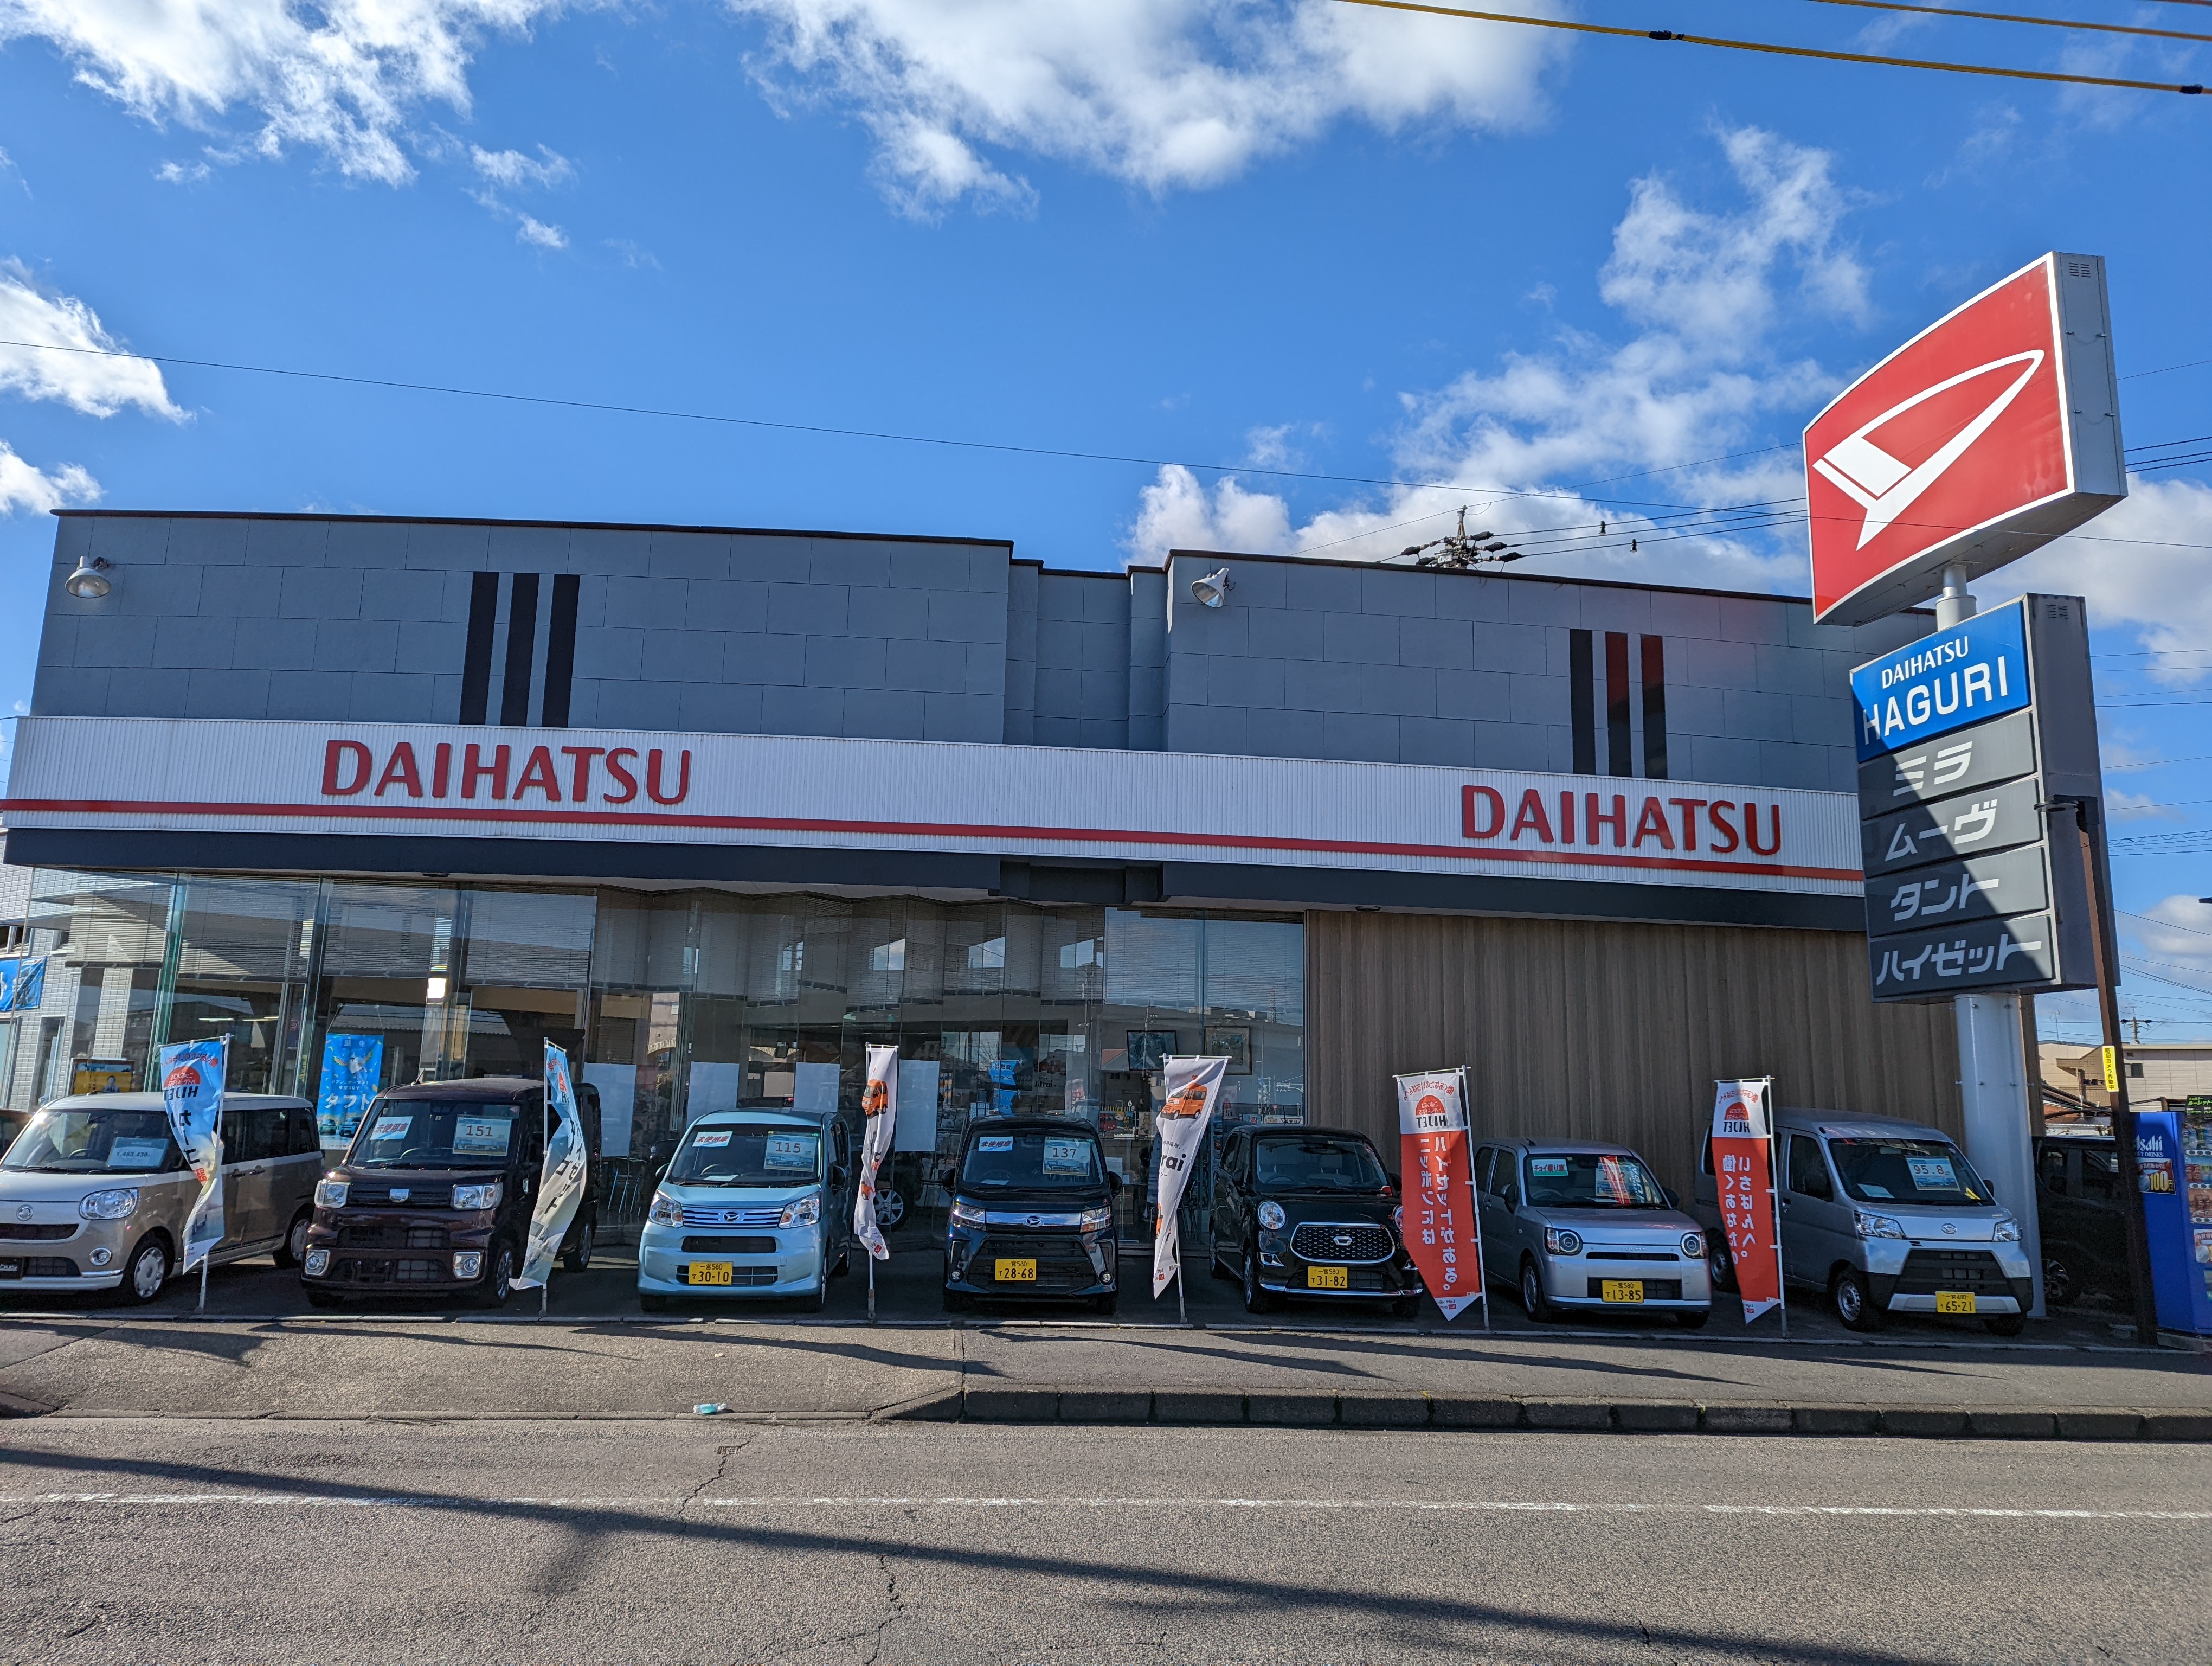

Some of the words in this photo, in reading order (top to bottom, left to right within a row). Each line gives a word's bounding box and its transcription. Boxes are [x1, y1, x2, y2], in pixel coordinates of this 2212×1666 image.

[1881, 636, 1969, 689] DAIHATSU
[1862, 656, 2009, 745] HAGURI
[321, 740, 691, 805] DAIHATSU
[1893, 741, 1973, 796] ミラ
[1462, 785, 1781, 855] DAIHATSU
[1885, 799, 1998, 862] ムーヴ
[1891, 873, 1999, 921] タント
[1876, 934, 2042, 985] ハイゼット
[2105, 1048, 2114, 1090] 防犯カメラ作動中
[325, 1093, 370, 1110] タフト
[374, 1123, 409, 1133] 未使用車
[466, 1125, 493, 1137] 151
[775, 1142, 801, 1154] 115
[2134, 1135, 2163, 1151] Asahi
[1052, 1147, 1076, 1158] 137
[1161, 1153, 1187, 1172] rai
[1534, 1164, 1565, 1172] チョイ乗り車
[698, 1271, 729, 1283] 30-10
[1004, 1268, 1033, 1279] 28-68
[1317, 1275, 1346, 1287] 31-82
[1613, 1289, 1641, 1300] 13-85
[1946, 1300, 1972, 1312] 65-21
